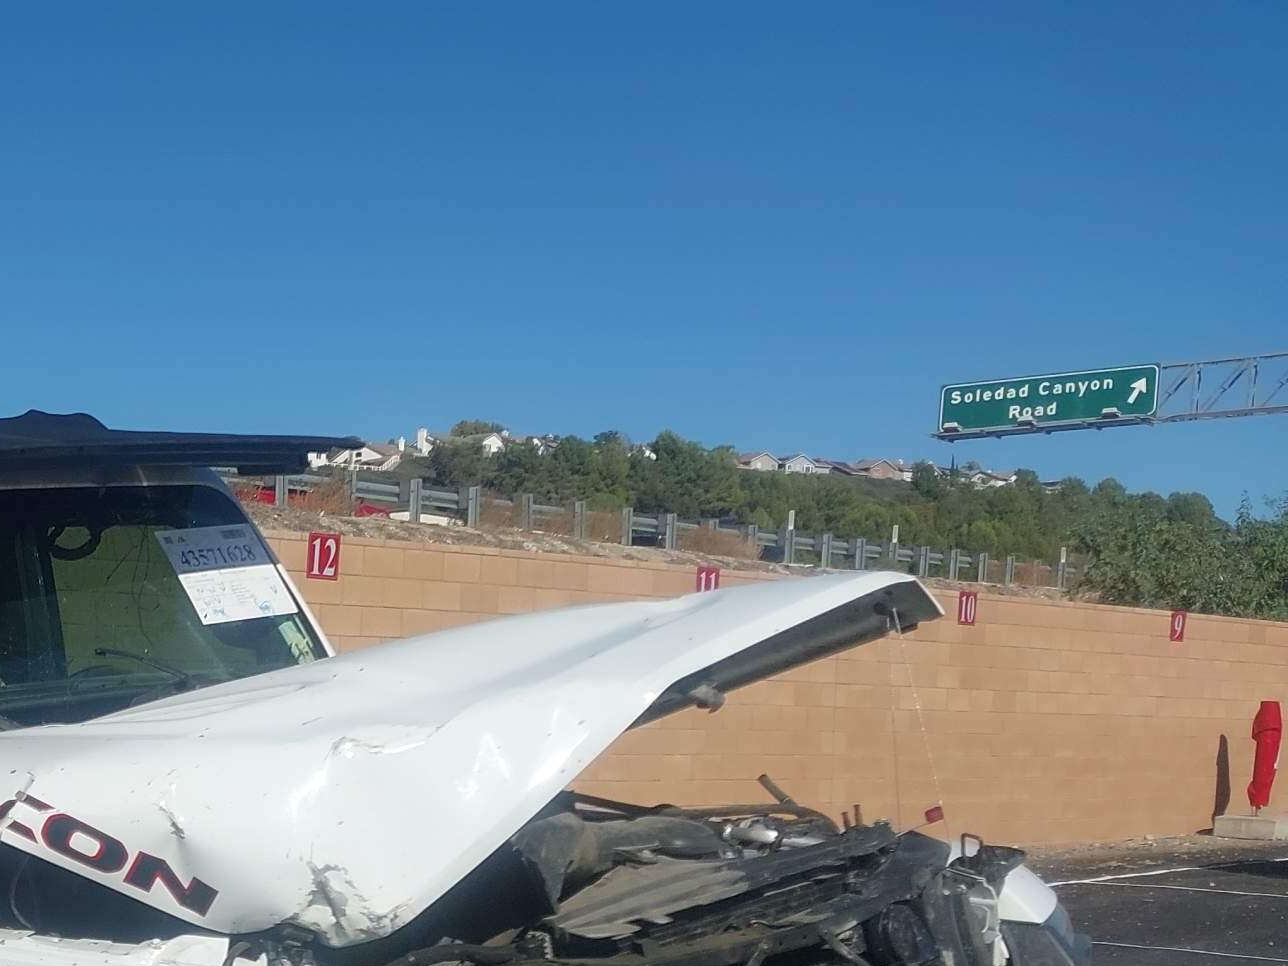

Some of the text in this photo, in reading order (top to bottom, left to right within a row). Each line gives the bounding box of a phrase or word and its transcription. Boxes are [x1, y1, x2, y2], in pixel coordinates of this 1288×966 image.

[950, 378, 1114, 405] Soledad Canyon
[1008, 401, 1058, 420] Road
[179, 543, 258, 568] 43571628
[311, 537, 337, 577] 12
[699, 571, 716, 593] 11
[959, 595, 976, 623] 10
[1173, 614, 1183, 639] 9
